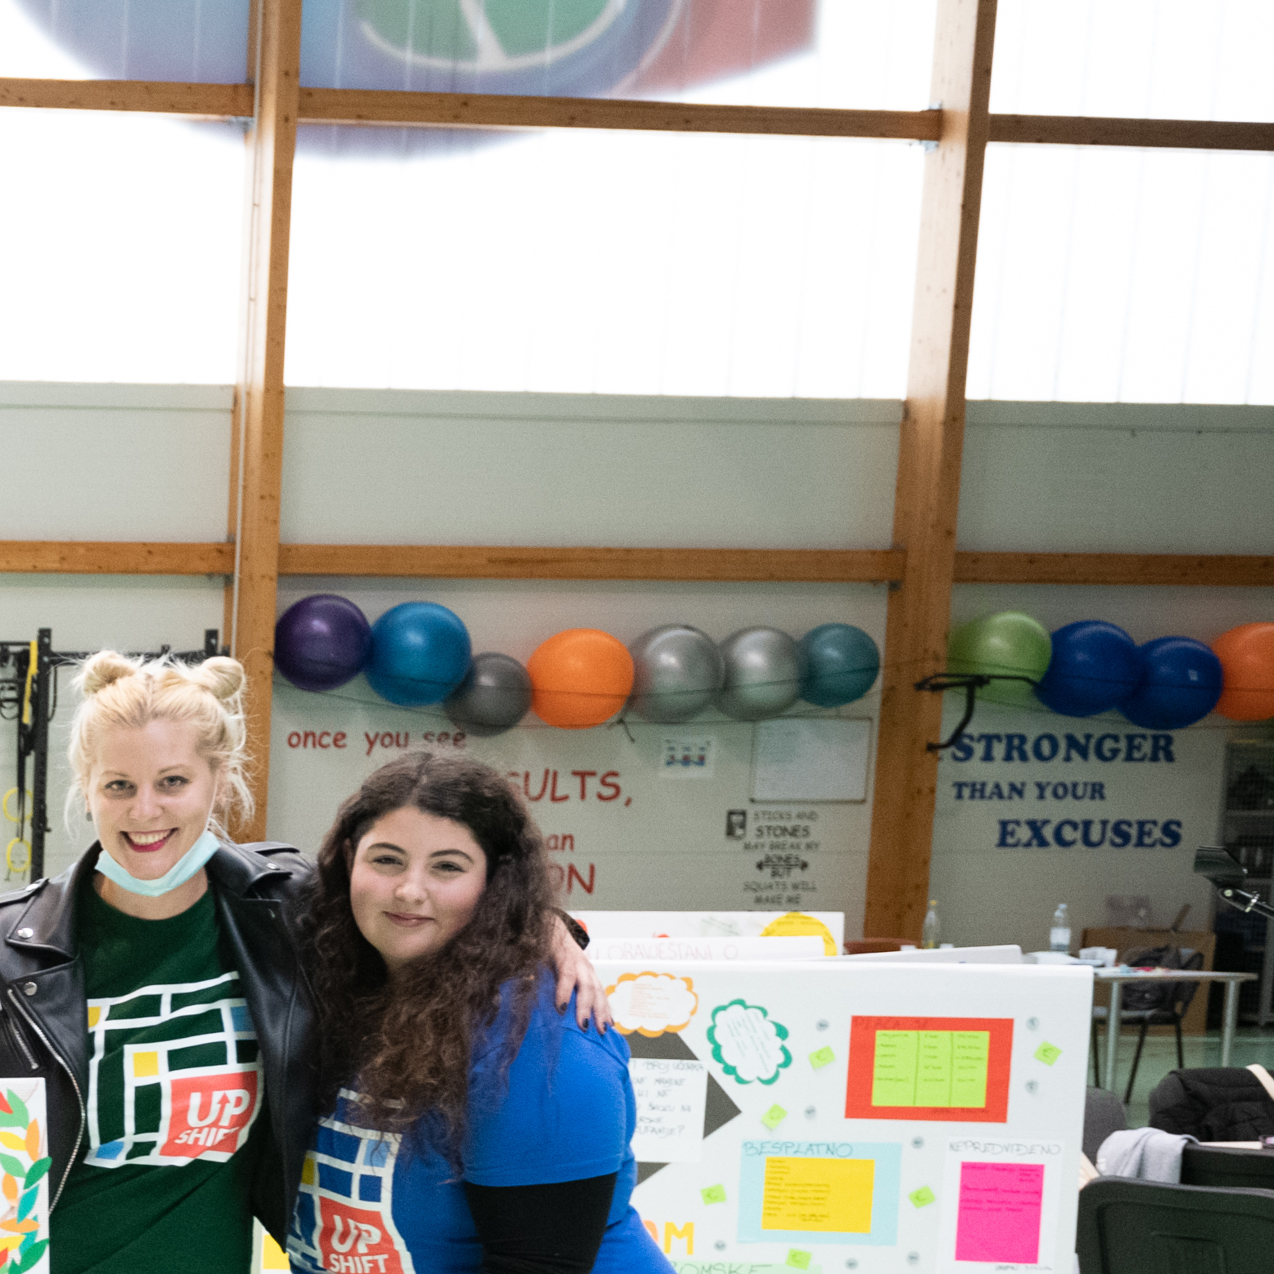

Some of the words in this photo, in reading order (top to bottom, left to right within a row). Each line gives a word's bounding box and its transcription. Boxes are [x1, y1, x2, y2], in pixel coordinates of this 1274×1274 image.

[287, 730, 347, 749] once
[365, 729, 409, 755] you
[952, 733, 1175, 762] STRONGER
[507, 767, 633, 808] SULTS,
[953, 781, 1026, 800] THAN
[1034, 781, 1106, 800] YOUR
[756, 825, 810, 838] STONES
[996, 819, 1182, 848] EXCUSES
[771, 869, 791, 879] BUT
[187, 1088, 251, 1128] UP
[174, 1126, 239, 1147] SHIF
[744, 1141, 853, 1158] BESPLATNO
[331, 1214, 382, 1253] UP
[330, 1253, 389, 1274] SHIFT
